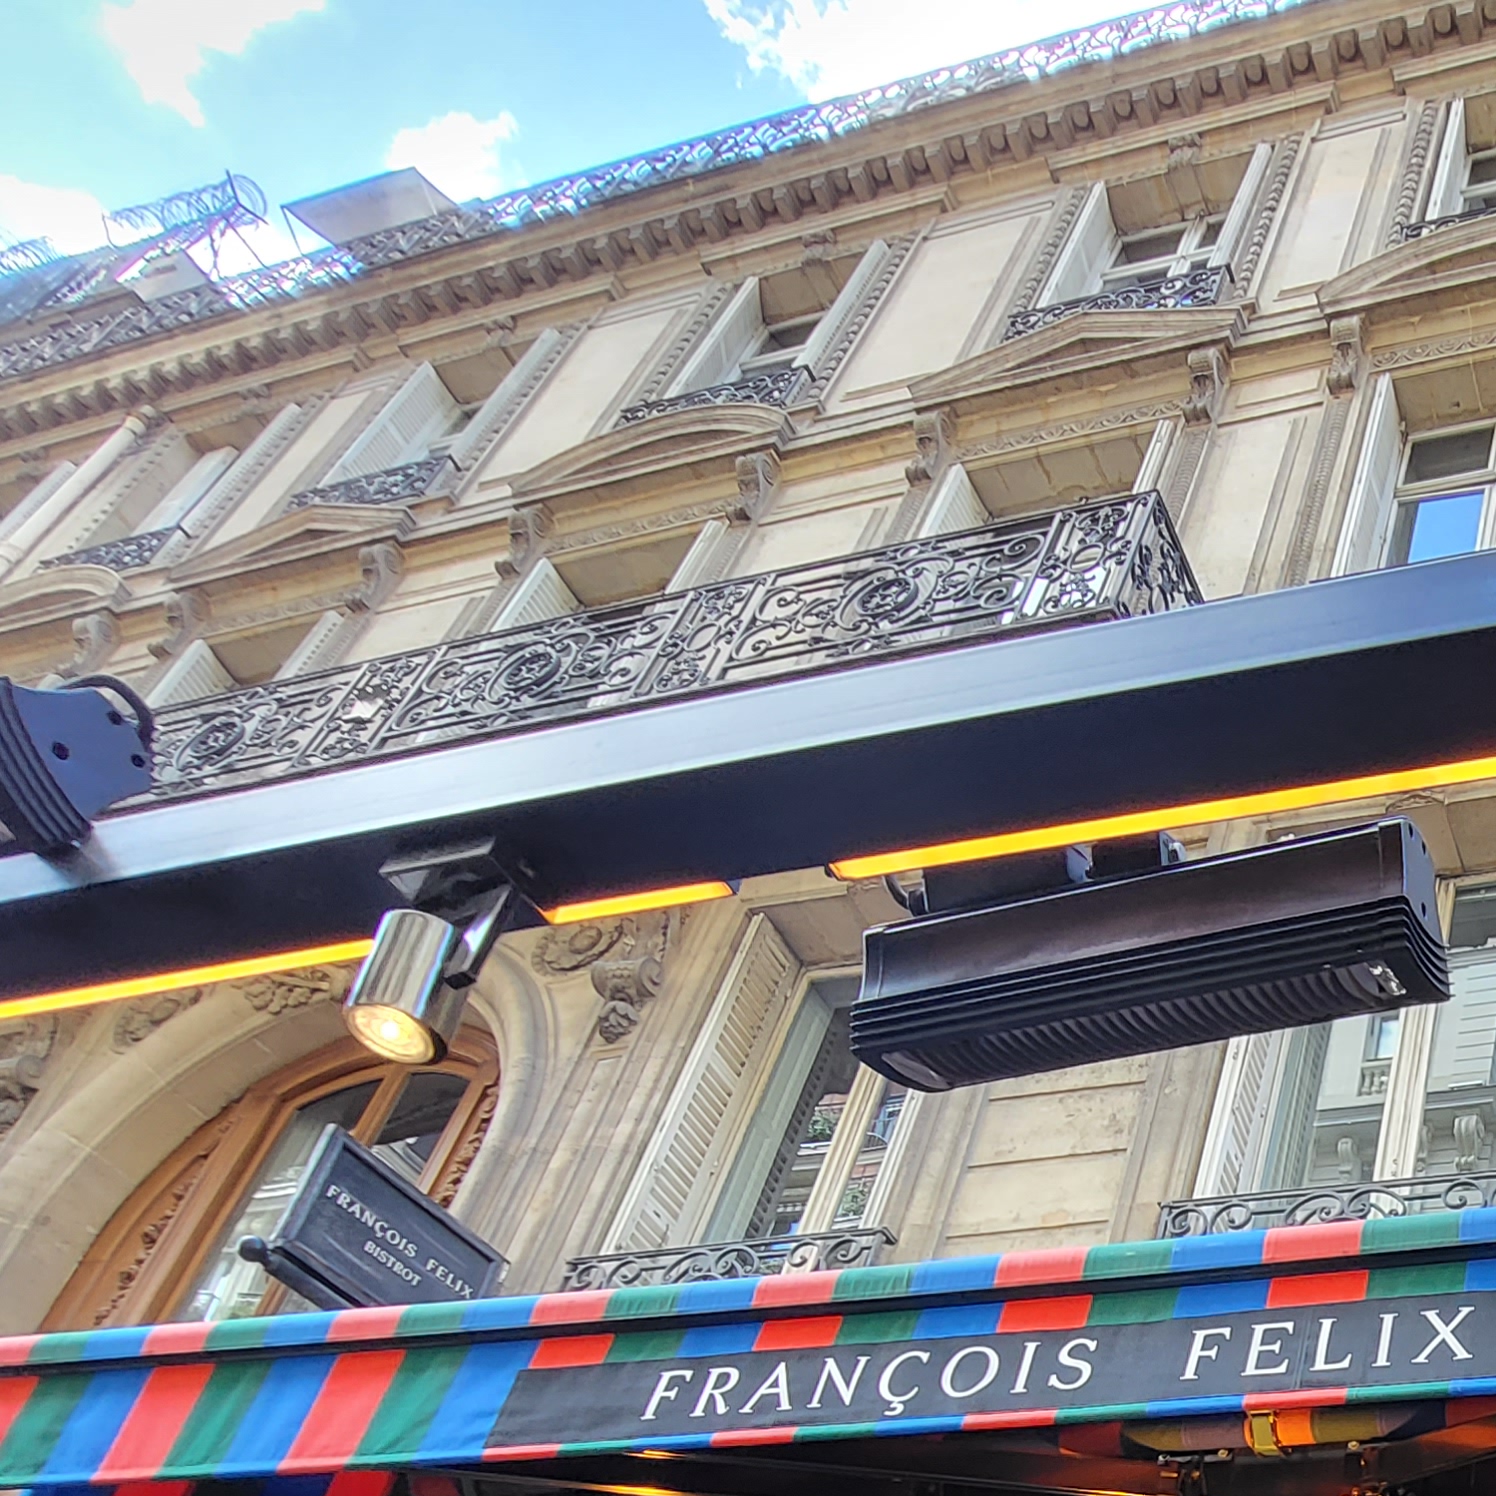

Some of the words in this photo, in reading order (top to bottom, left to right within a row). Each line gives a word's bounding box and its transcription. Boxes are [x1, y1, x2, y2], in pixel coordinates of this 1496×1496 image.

[325, 1184, 419, 1258] FRANÇOIS
[425, 1258, 474, 1299] FELIX
[363, 1240, 422, 1286] BISTROT
[640, 1338, 1098, 1416] FRANÇOIS
[1179, 1306, 1476, 1381] FELIX
